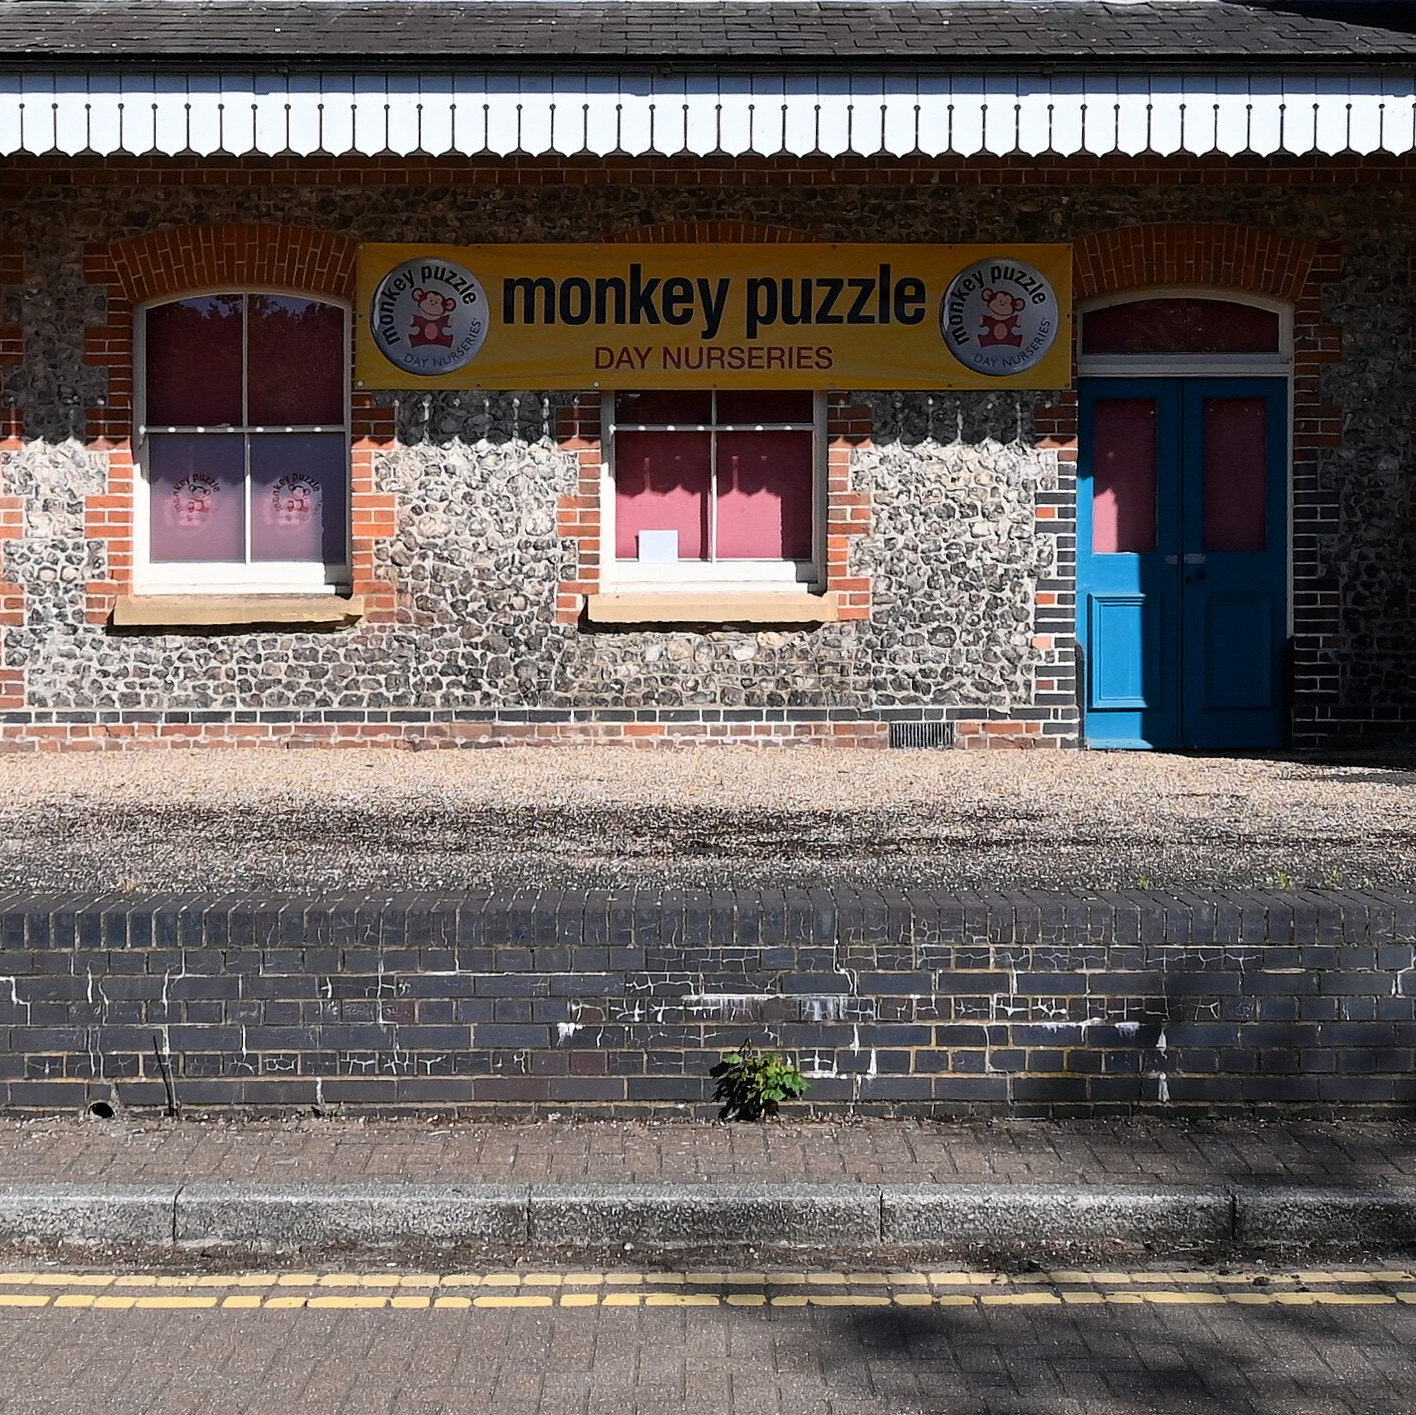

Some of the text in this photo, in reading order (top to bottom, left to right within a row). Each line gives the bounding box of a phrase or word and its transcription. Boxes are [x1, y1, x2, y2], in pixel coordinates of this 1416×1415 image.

[379, 265, 478, 346] monkey puzzle
[502, 263, 927, 340] monkey puzzle
[948, 265, 1047, 346] monkey puzzle
[403, 319, 482, 368] DAY NURSERIES
[594, 346, 834, 370] DAY NURSERIES
[973, 319, 1051, 368] DAY NURSERIES
[173, 473, 221, 513] monkey puzzle
[272, 475, 290, 512] monkey
[292, 472, 321, 492] puzzle
